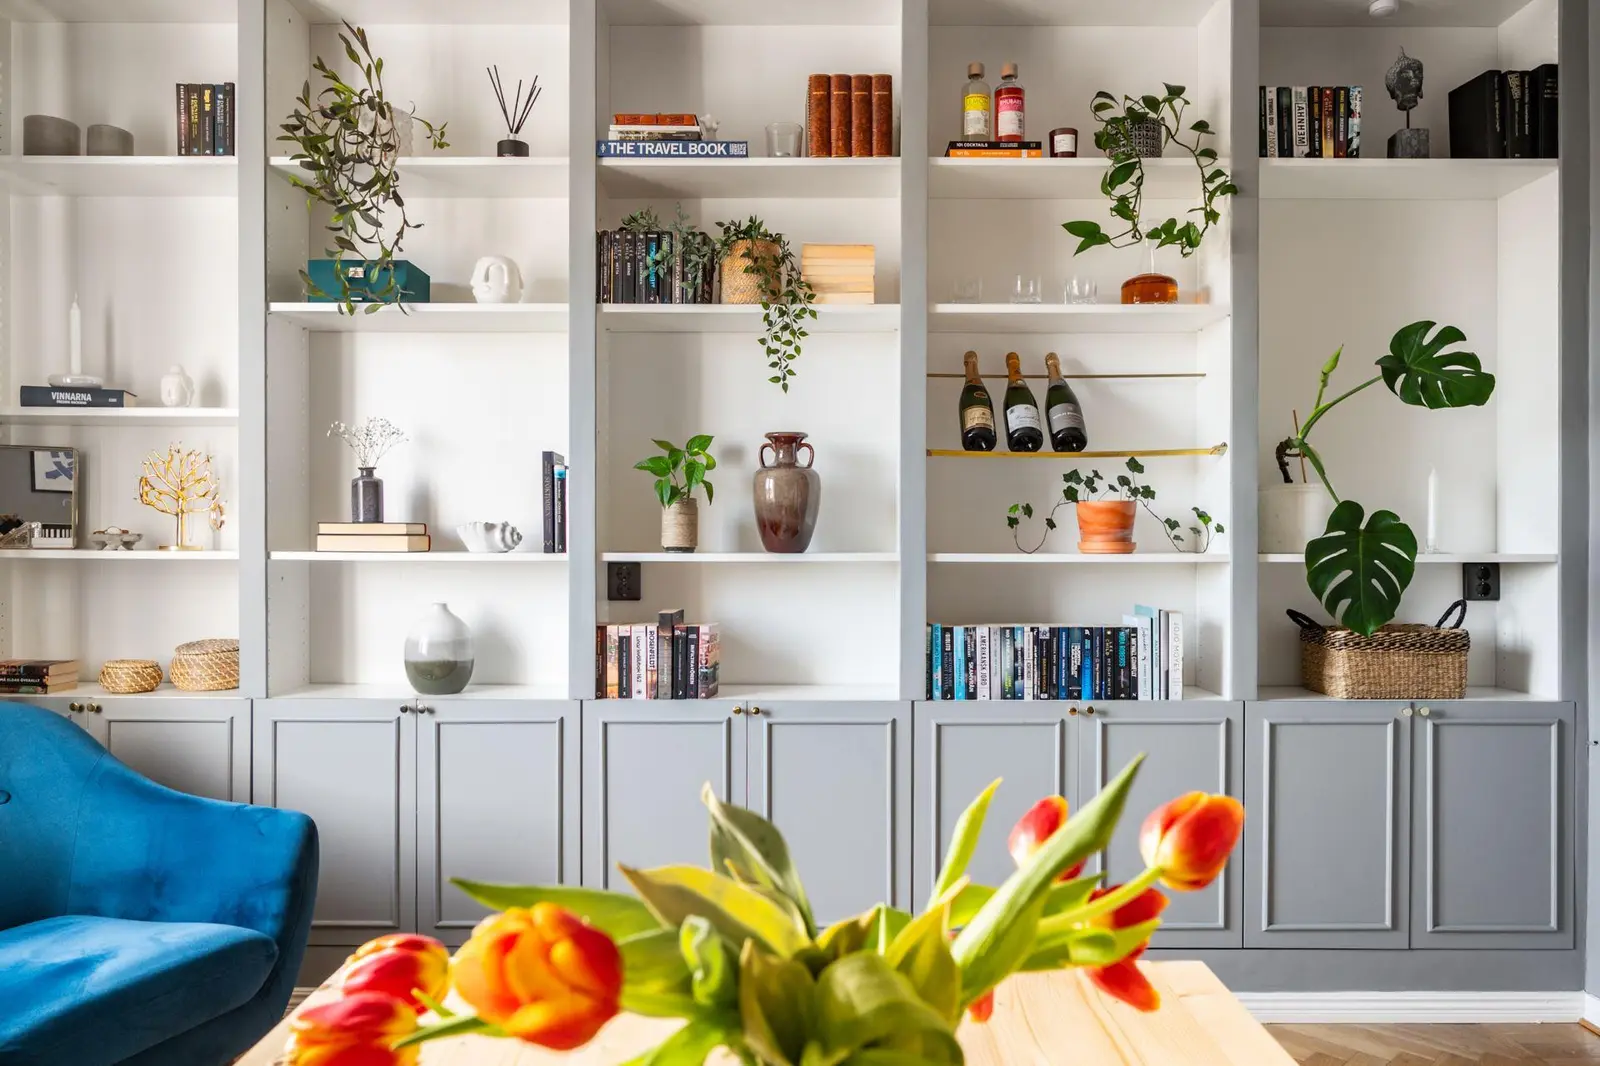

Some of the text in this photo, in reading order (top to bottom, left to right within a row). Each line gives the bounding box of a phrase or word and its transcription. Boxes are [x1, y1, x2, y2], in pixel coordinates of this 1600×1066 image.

[608, 142, 635, 154] THE
[636, 142, 687, 154] TRAVEL
[689, 143, 727, 154] BOOK
[51, 392, 92, 401] VINNARNA
